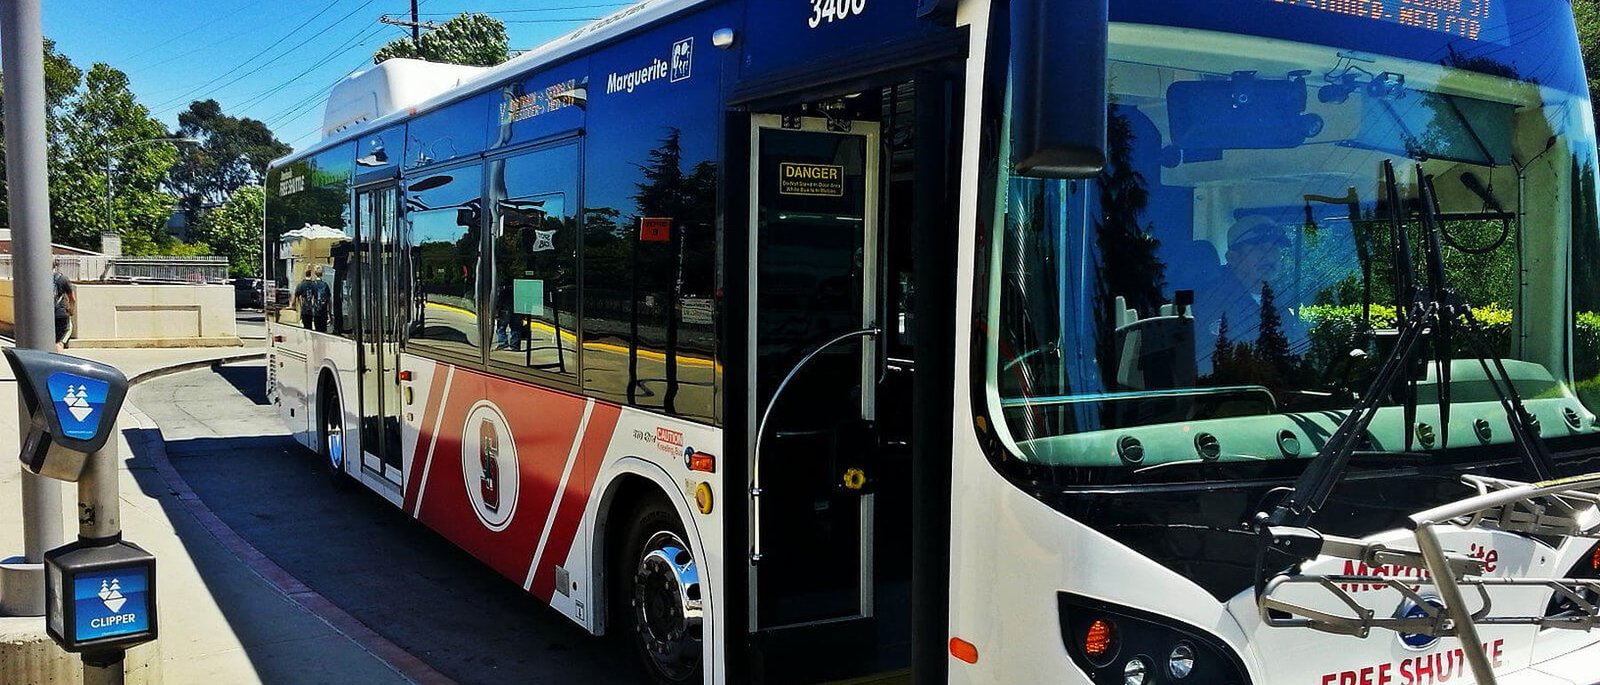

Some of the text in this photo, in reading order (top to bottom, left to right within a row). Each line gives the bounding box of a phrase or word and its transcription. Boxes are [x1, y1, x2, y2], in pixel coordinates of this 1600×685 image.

[606, 58, 668, 95] Marguerite
[786, 166, 837, 179] DANGER
[657, 428, 683, 447] CAUTION
[90, 613, 136, 629] CLIPPER
